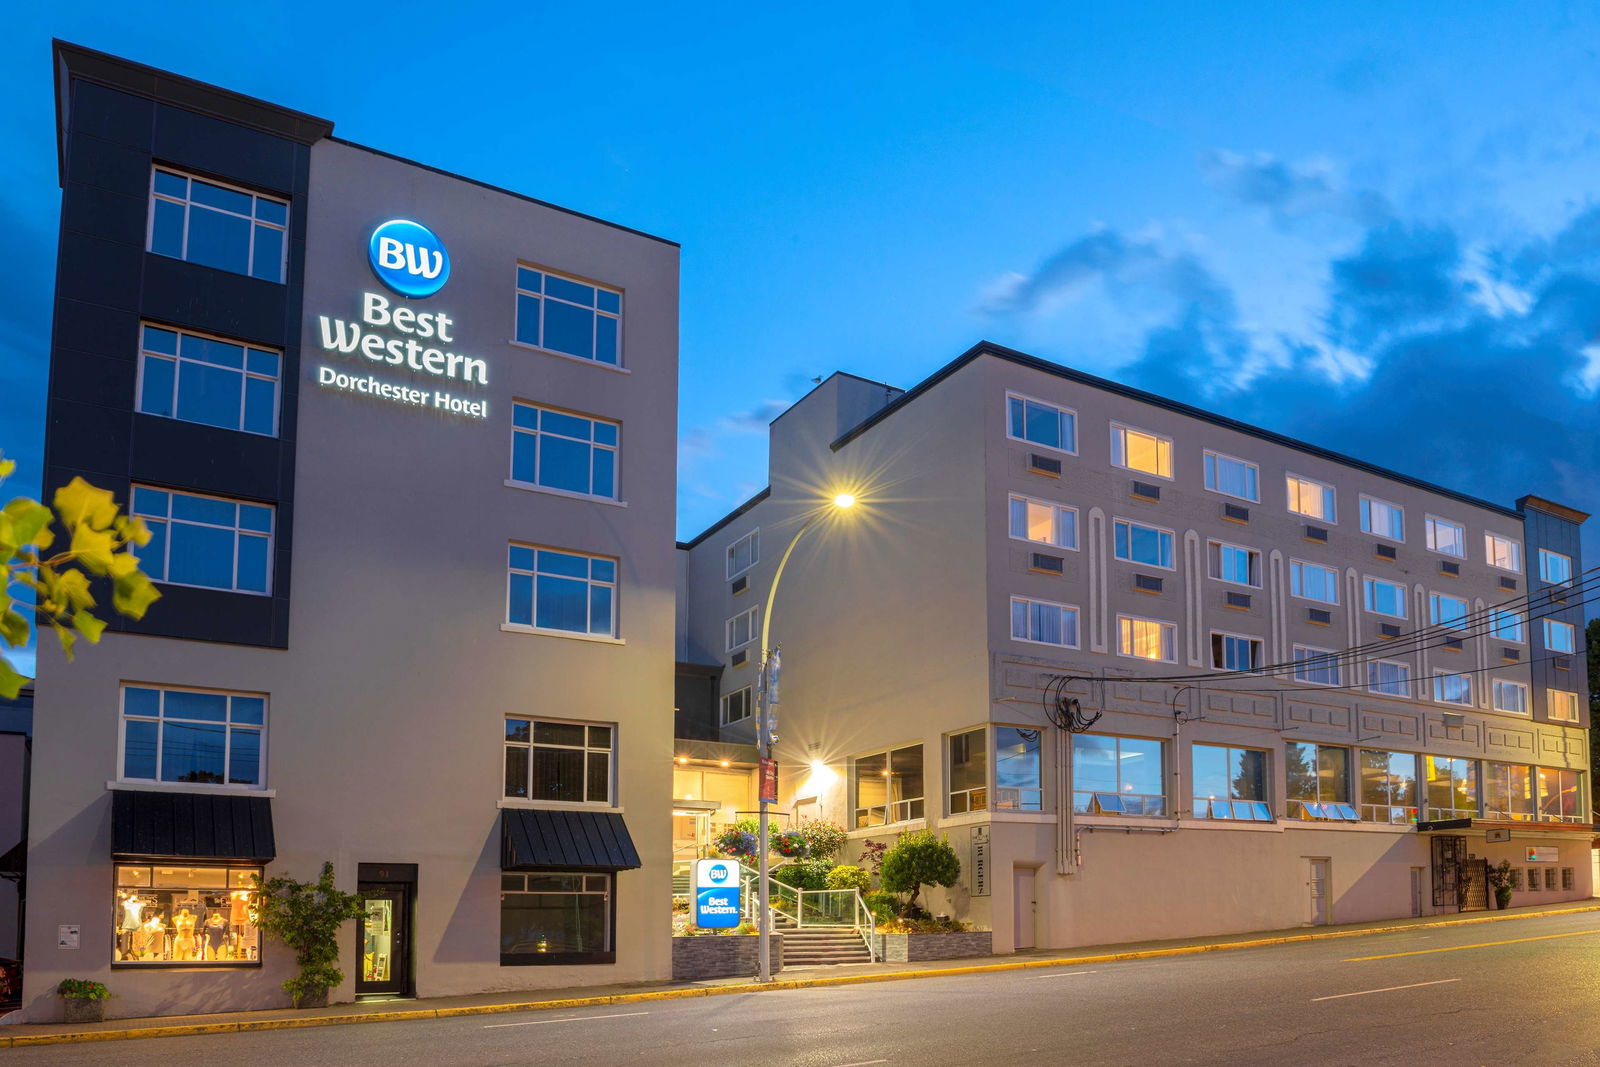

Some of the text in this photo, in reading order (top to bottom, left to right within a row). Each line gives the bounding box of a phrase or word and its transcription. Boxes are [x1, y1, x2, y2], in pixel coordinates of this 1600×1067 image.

[379, 236, 443, 279] BW
[363, 292, 454, 342] Best
[319, 315, 489, 385] Western
[319, 366, 487, 418] Dorchester Hotel
[710, 869, 727, 880] BW
[708, 897, 729, 906] Best
